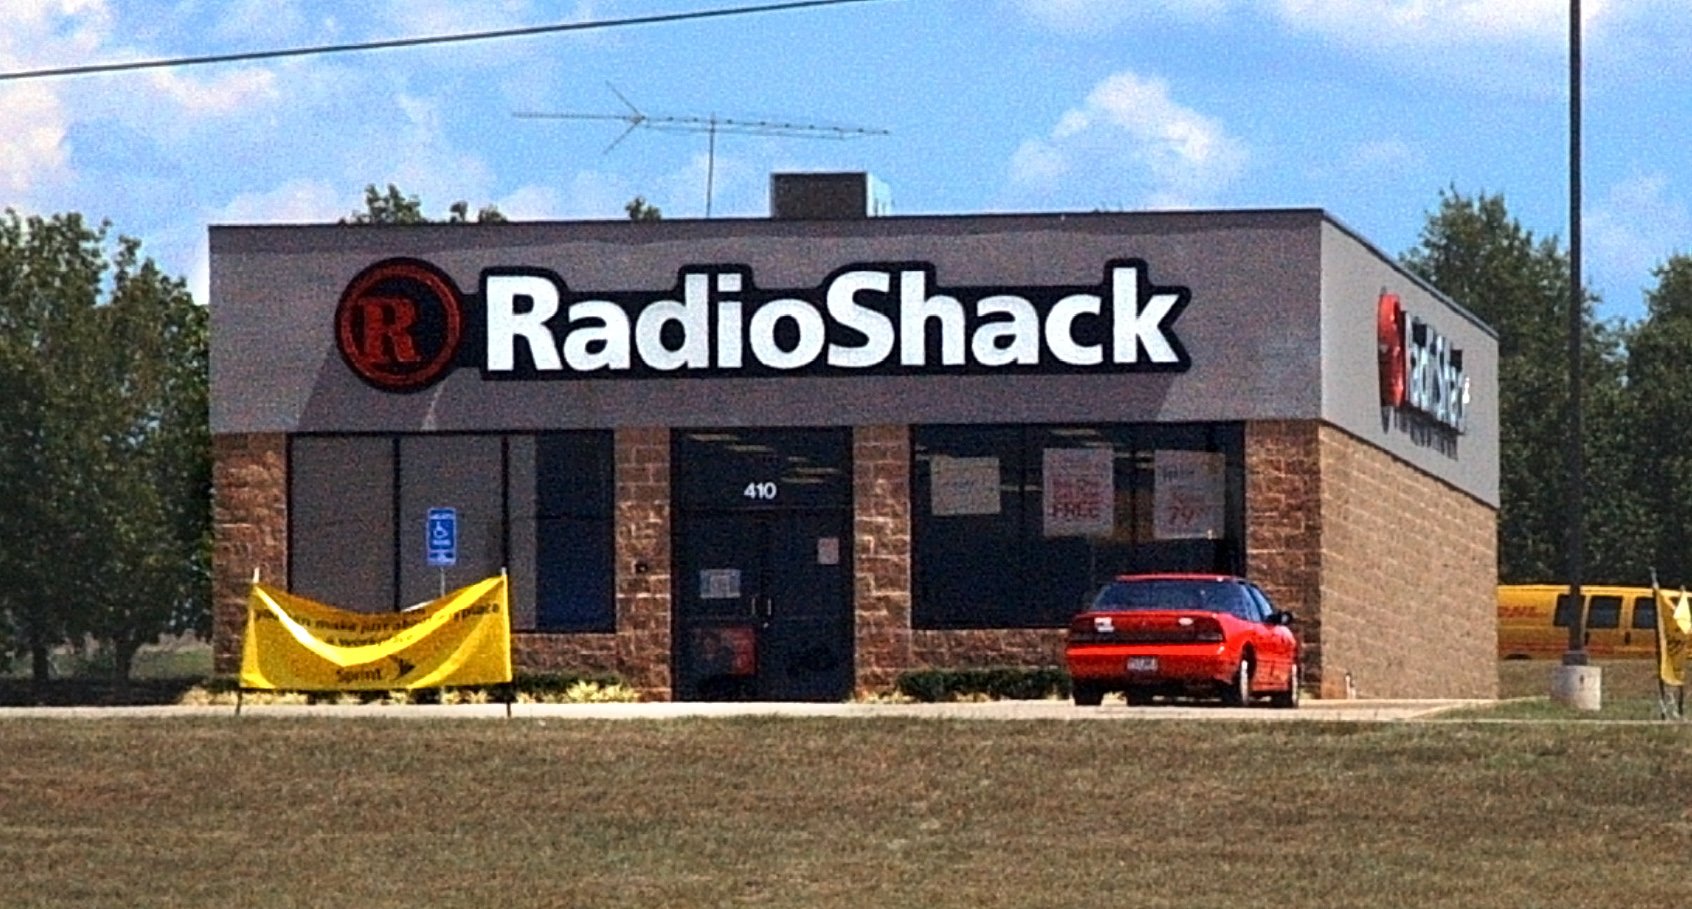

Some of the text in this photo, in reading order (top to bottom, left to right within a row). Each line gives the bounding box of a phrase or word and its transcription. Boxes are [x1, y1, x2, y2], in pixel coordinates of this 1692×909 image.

[486, 266, 1181, 372] RadioShack
[743, 481, 778, 500] 410
[336, 667, 382, 684] Sprint
